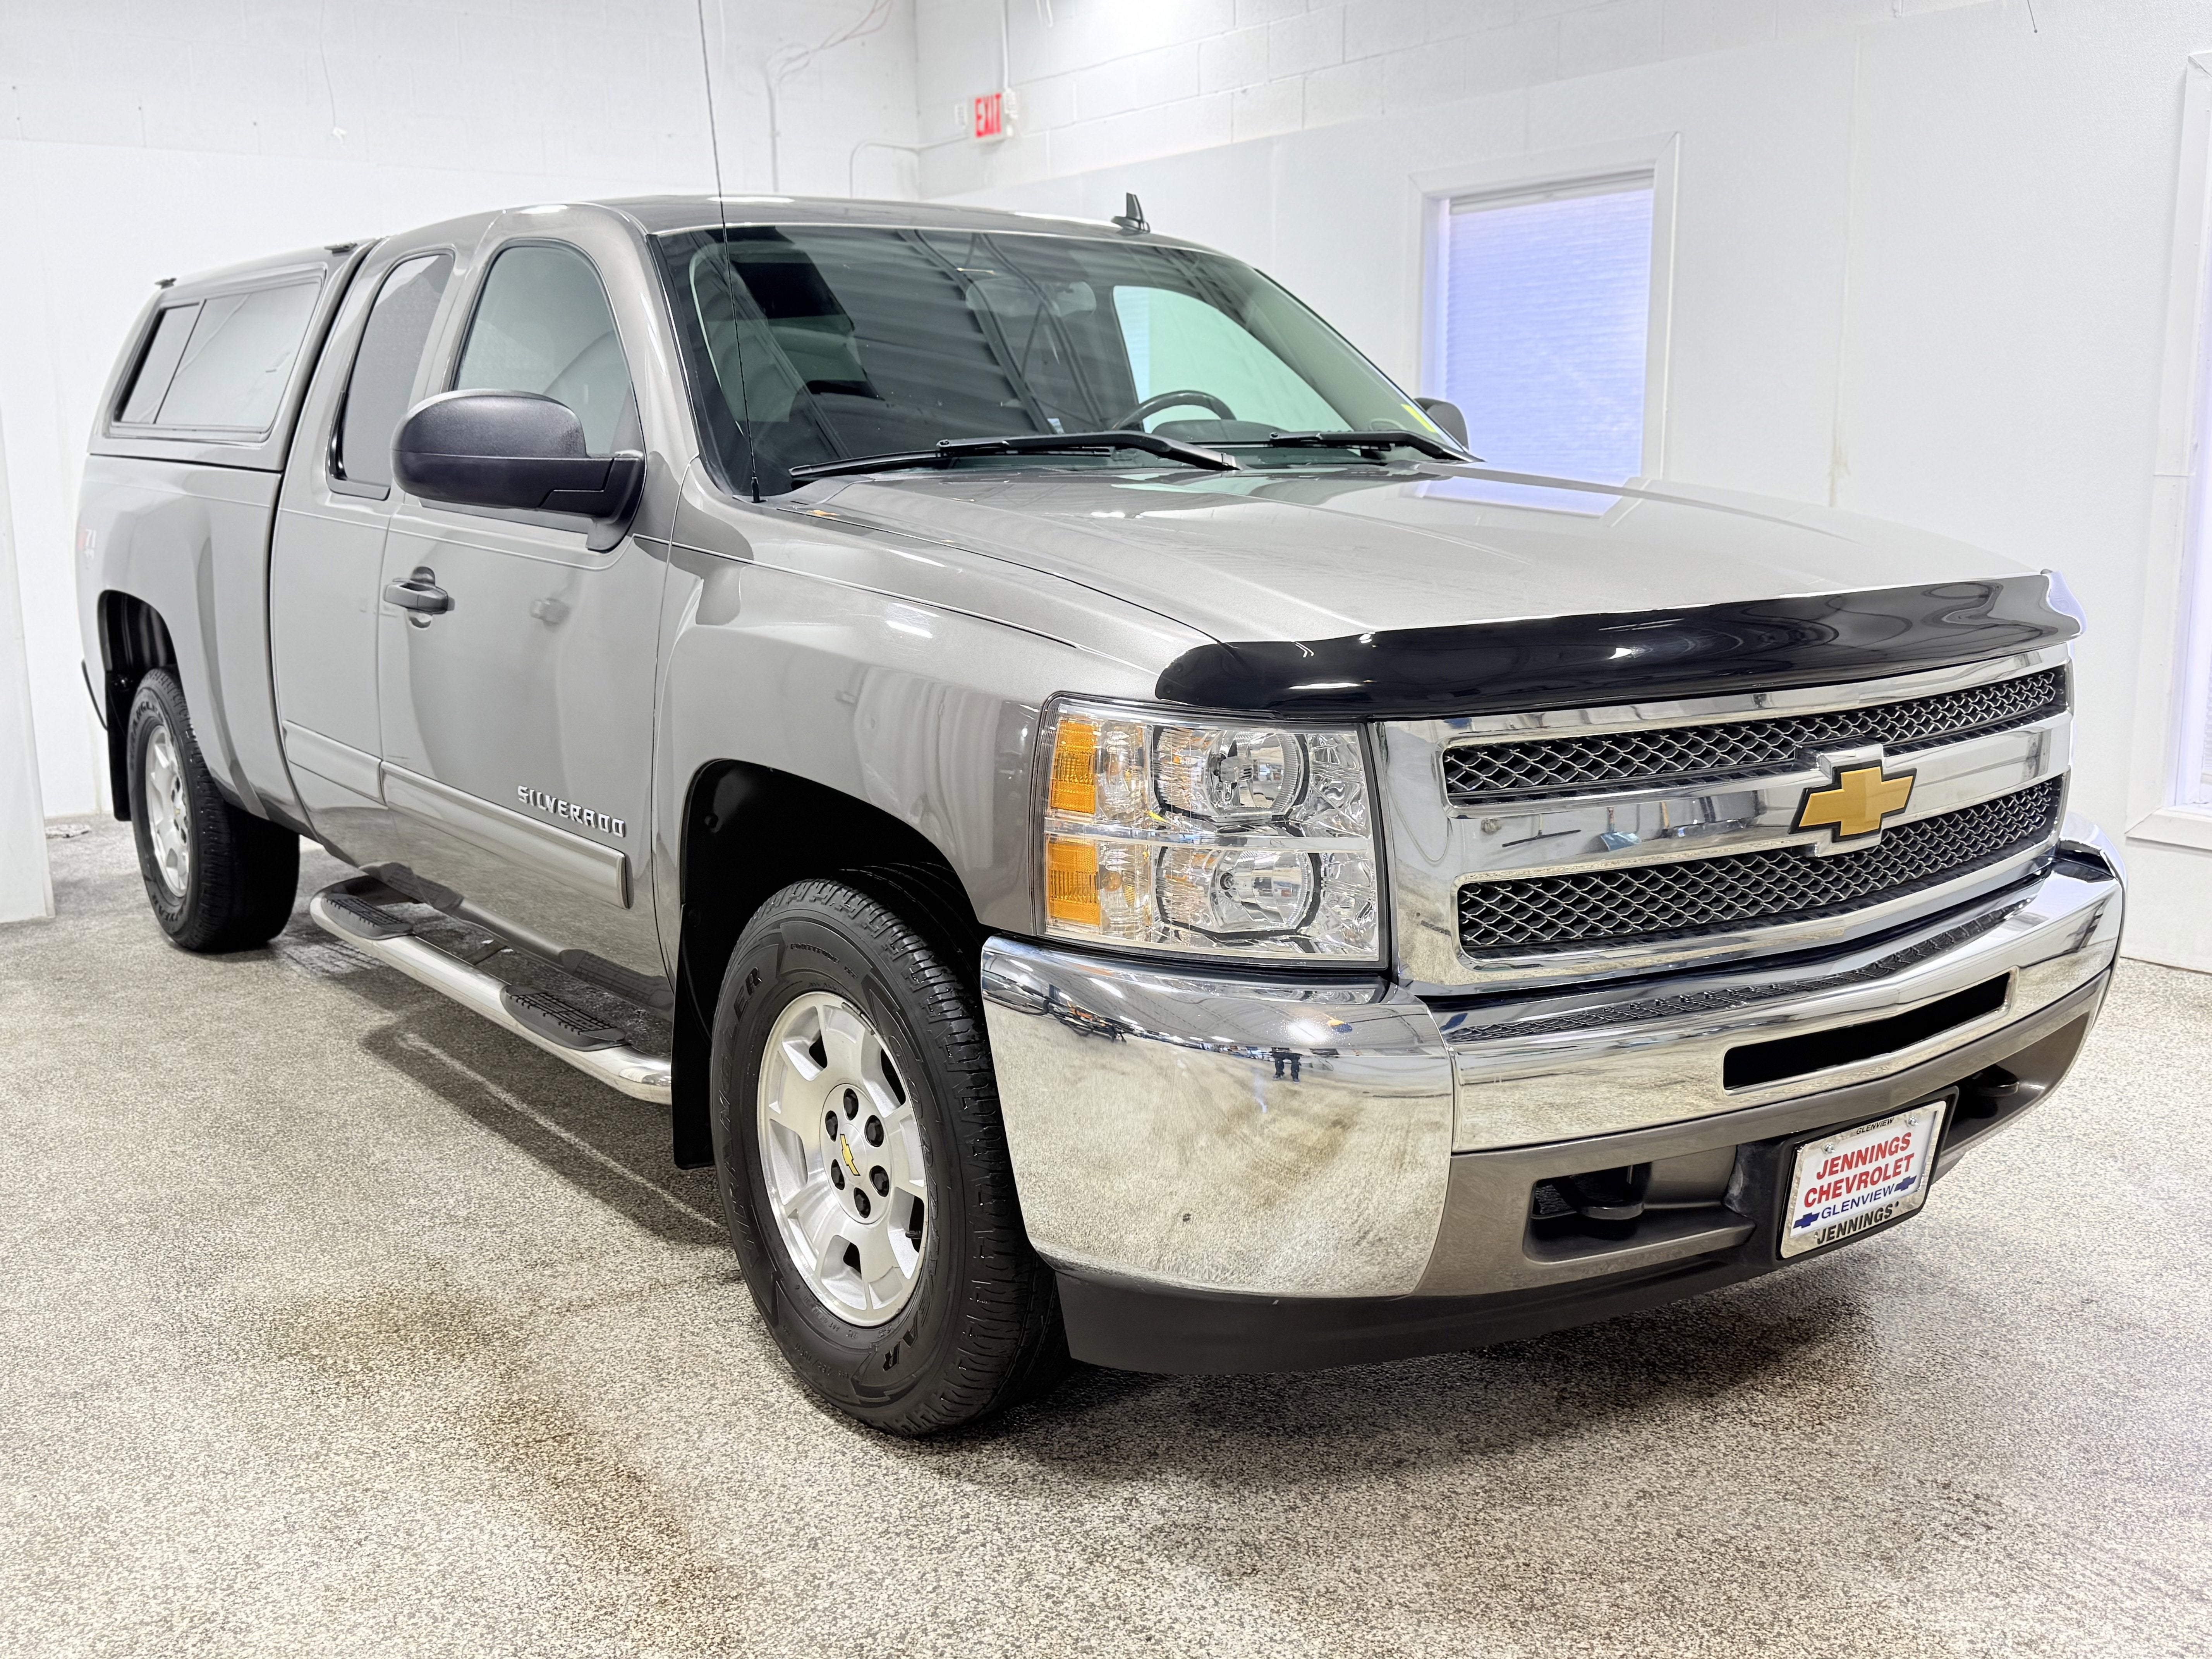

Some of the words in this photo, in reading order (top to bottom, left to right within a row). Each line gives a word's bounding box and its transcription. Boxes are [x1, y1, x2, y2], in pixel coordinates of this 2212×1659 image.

[975, 93, 1001, 137] EXIT
[517, 785, 626, 838] SILVERADO
[1856, 1117, 1894, 1135] GLENVIEW
[1816, 1132, 1912, 1180] JENNINGS
[1804, 1153, 1914, 1207] CHEVROLET
[1821, 1184, 1895, 1219] GLENVIEW
[1817, 1203, 1893, 1245] JENNINGS
